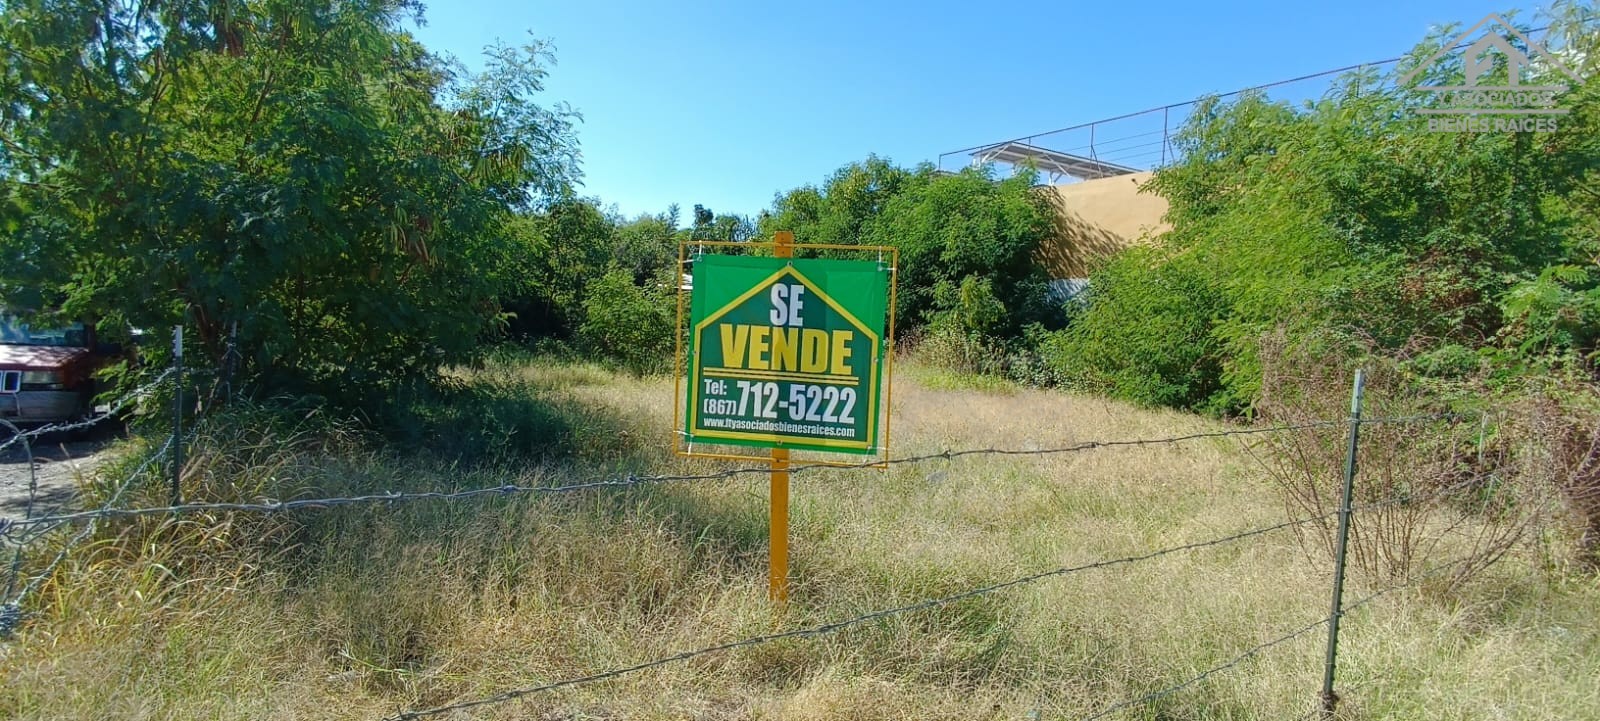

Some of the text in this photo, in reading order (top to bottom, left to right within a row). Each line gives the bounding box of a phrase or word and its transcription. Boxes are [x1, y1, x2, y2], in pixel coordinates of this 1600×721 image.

[769, 283, 805, 327] SE
[720, 323, 853, 375] VENDE
[703, 379, 728, 396] Tel:
[703, 380, 857, 424] (867) 712-5222
